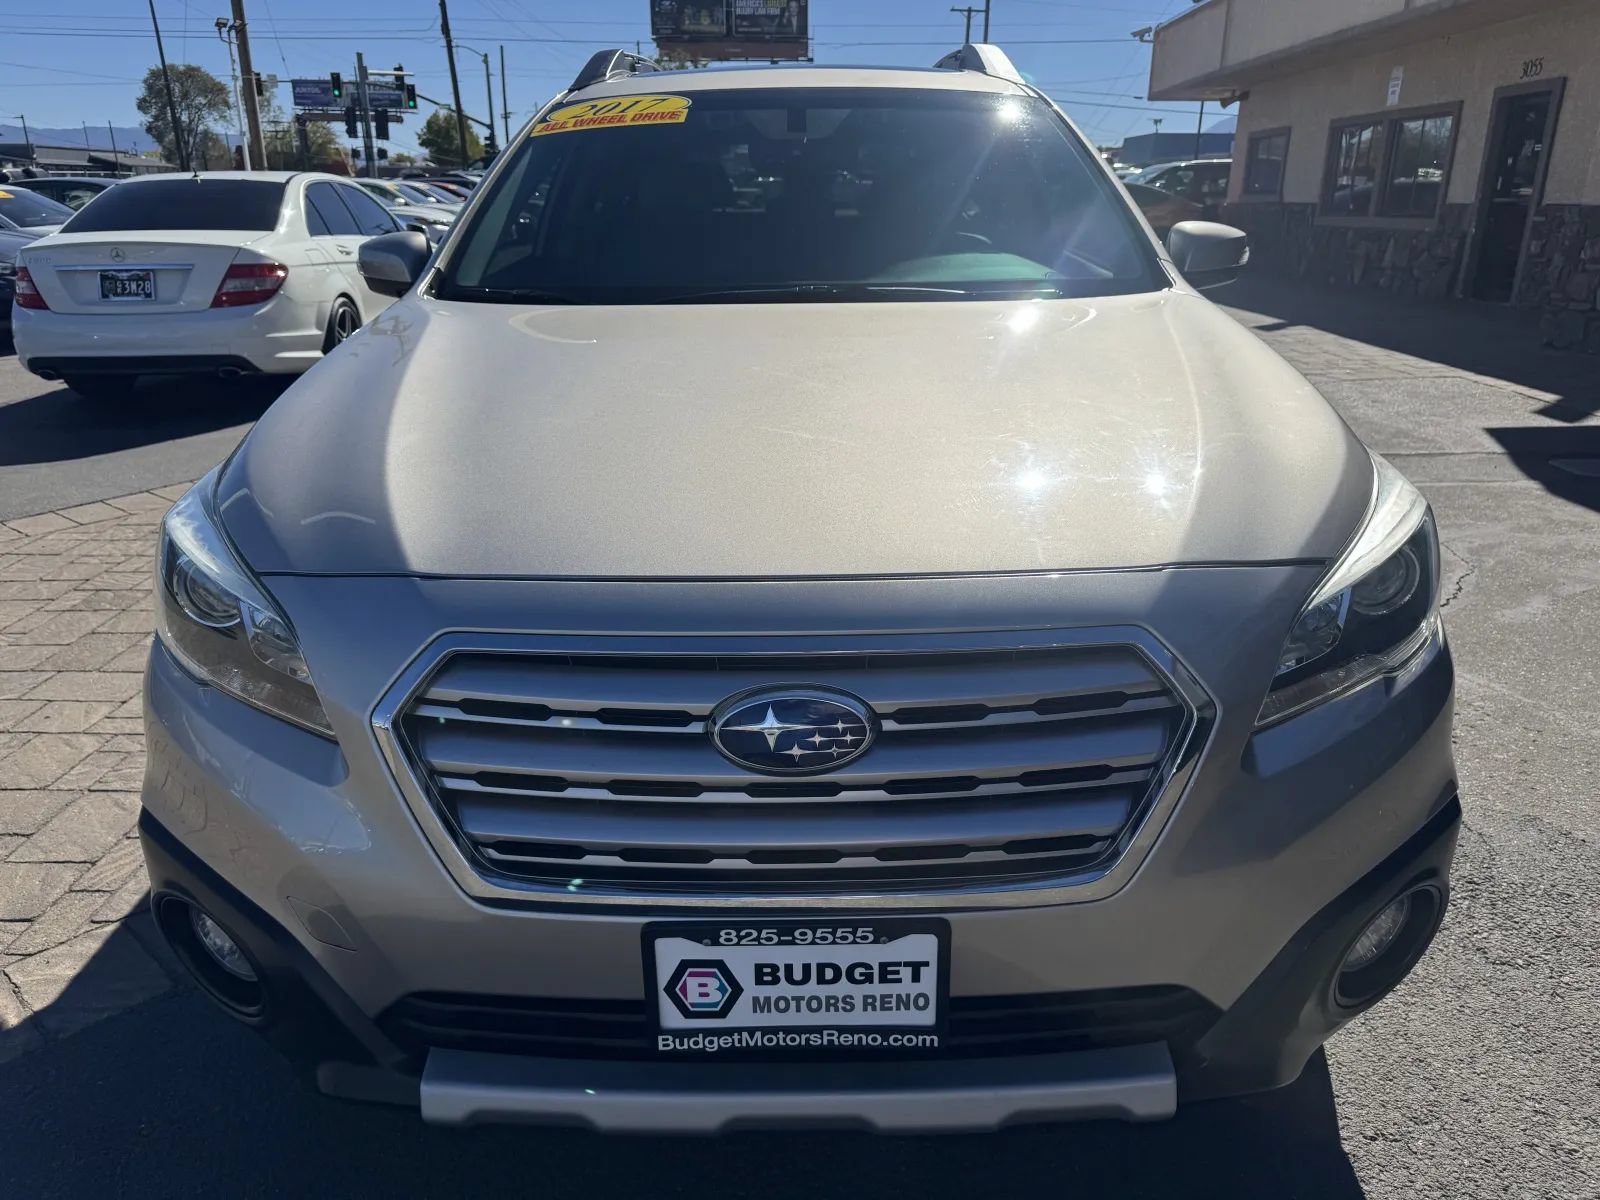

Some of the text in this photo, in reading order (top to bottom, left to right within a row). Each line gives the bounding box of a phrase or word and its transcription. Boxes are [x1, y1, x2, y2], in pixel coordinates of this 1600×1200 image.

[1520, 57, 1544, 79] 3055
[570, 98, 669, 118] 2017
[537, 110, 684, 133] ALL WHEEL DRIVE
[718, 927, 875, 945] 825-9555
[753, 960, 930, 986] BUDGET
[685, 976, 723, 1004] B
[751, 992, 930, 1014] MOTORS RENO
[657, 1030, 939, 1052] BudgetMotorsReno.com
